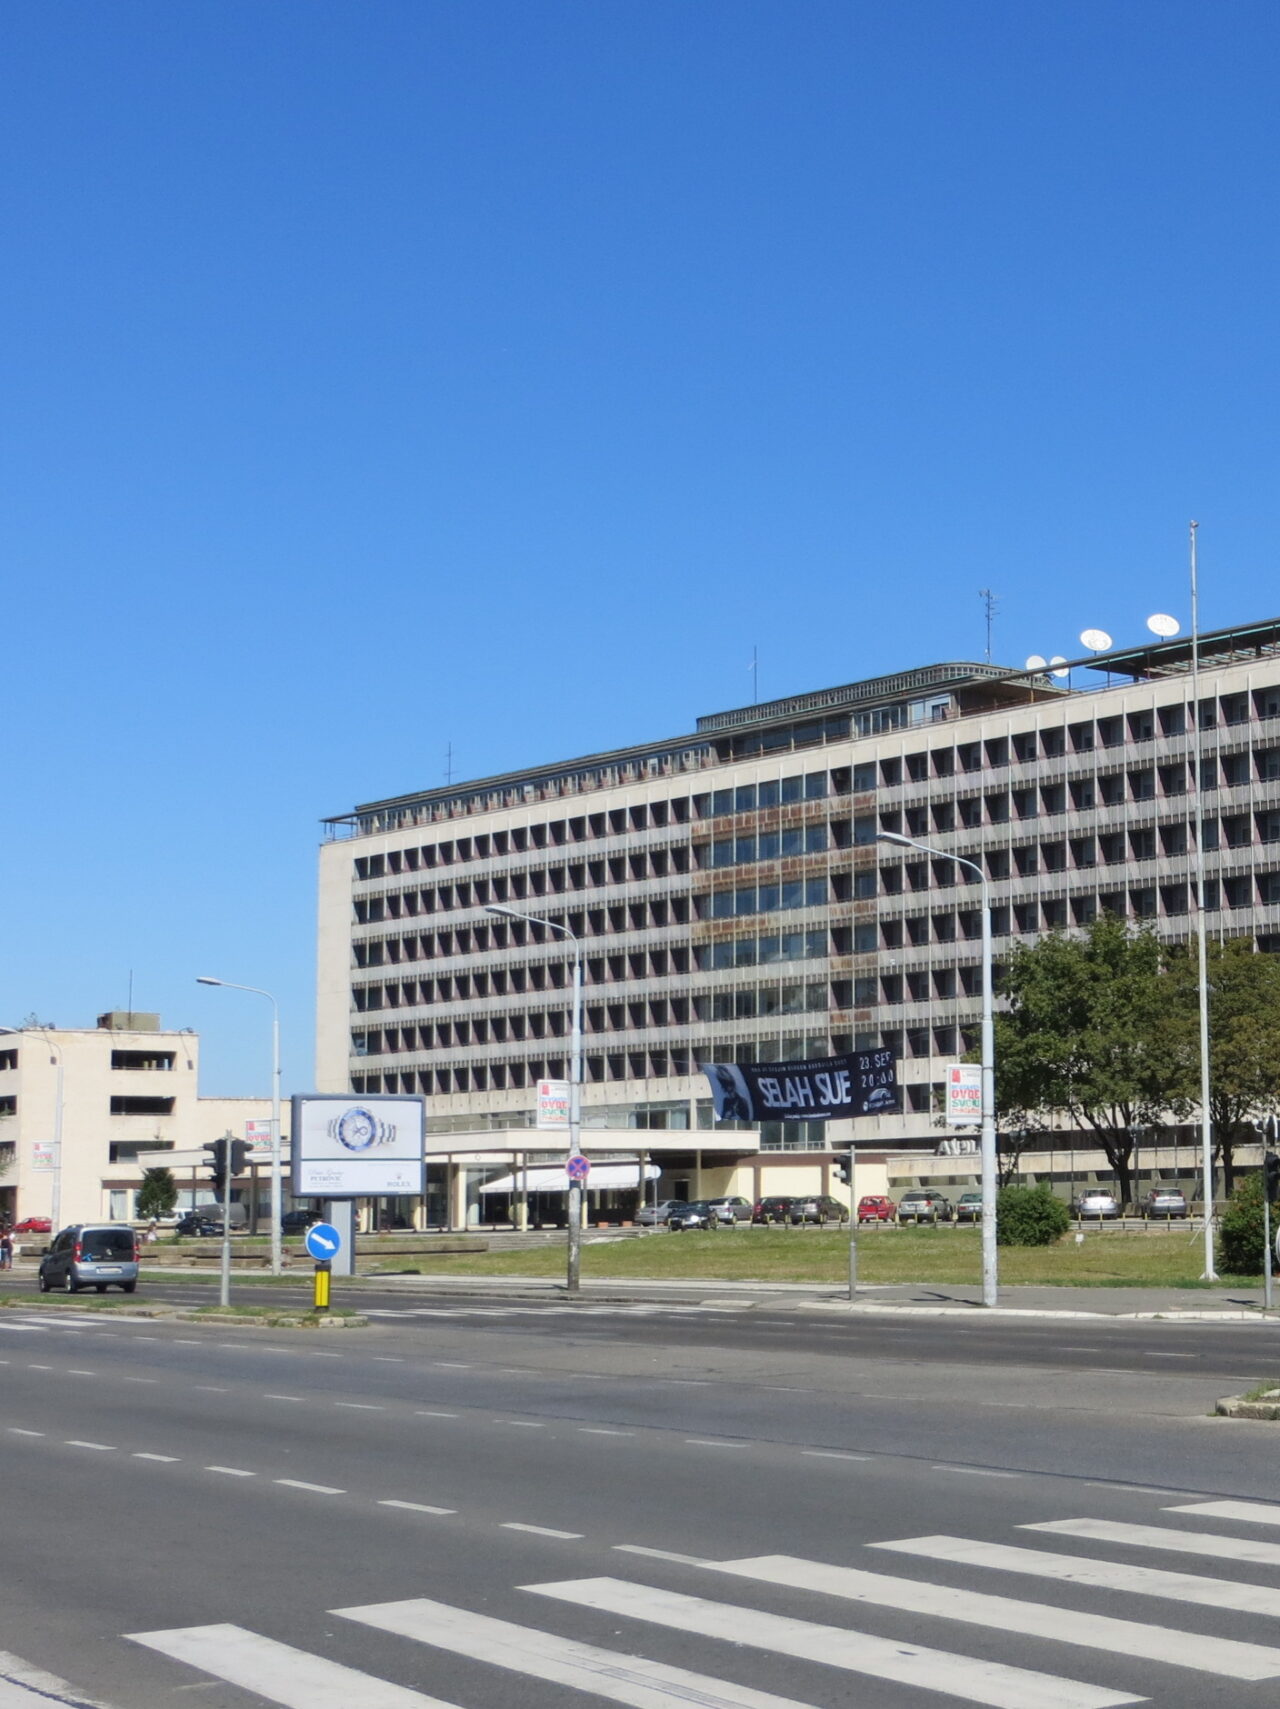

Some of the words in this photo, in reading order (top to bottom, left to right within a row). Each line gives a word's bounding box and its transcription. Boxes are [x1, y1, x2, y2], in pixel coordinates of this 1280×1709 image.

[859, 1056, 873, 1070] 23.
[861, 1069, 894, 1088] 20:00
[757, 1076, 815, 1108] SELAH
[815, 1070, 852, 1106] SUE
